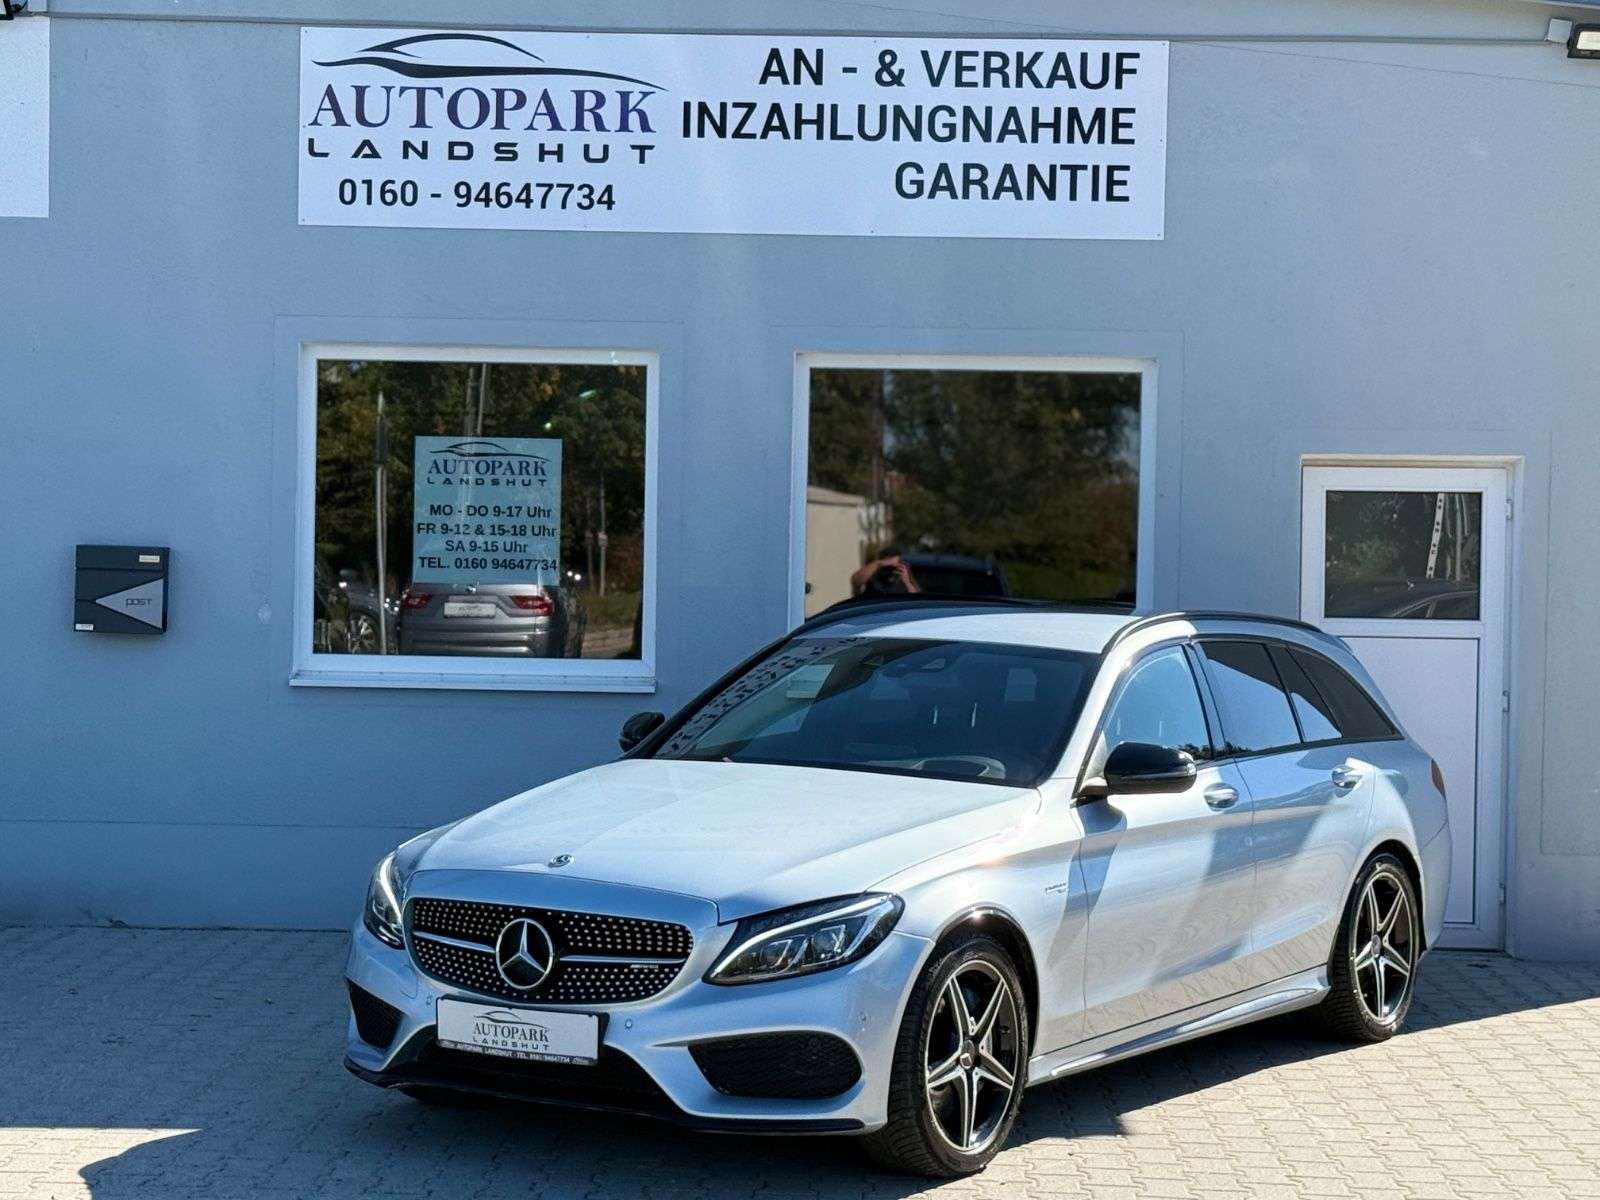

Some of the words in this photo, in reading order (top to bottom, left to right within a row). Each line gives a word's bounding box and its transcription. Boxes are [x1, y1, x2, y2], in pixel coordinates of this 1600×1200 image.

[759, 47, 824, 86] AN
[842, 66, 858, 74] -
[874, 48, 906, 87] &
[920, 50, 1141, 90] VERKAUF
[308, 83, 657, 134] AUTOPARK
[682, 101, 1136, 145] INZAHLUNGNAHME
[307, 138, 656, 165] LANDSHUT
[894, 161, 1131, 202] GARANTIE
[338, 178, 419, 207] 0160
[454, 181, 616, 211] 94647734
[428, 459, 547, 476] AUTOPARK
[428, 477, 547, 486] LANDSHUT
[429, 504, 453, 516] MO
[466, 505, 489, 517] DO
[492, 505, 521, 517] 9-17
[527, 506, 552, 519] Uhr
[417, 523, 436, 535] FR
[440, 523, 471, 535] 9-12
[474, 524, 485, 536] &
[489, 524, 527, 536] 15-18
[531, 525, 557, 538] Uhr
[445, 540, 465, 552] SA
[469, 540, 499, 551] 9-15
[503, 541, 528, 553] Uhr
[418, 556, 450, 569] TEL.
[454, 557, 487, 570] 0160
[491, 558, 558, 571] 94647734
[473, 1022, 549, 1042] AUTOPARK
[472, 1037, 550, 1051] LANDSHUT
